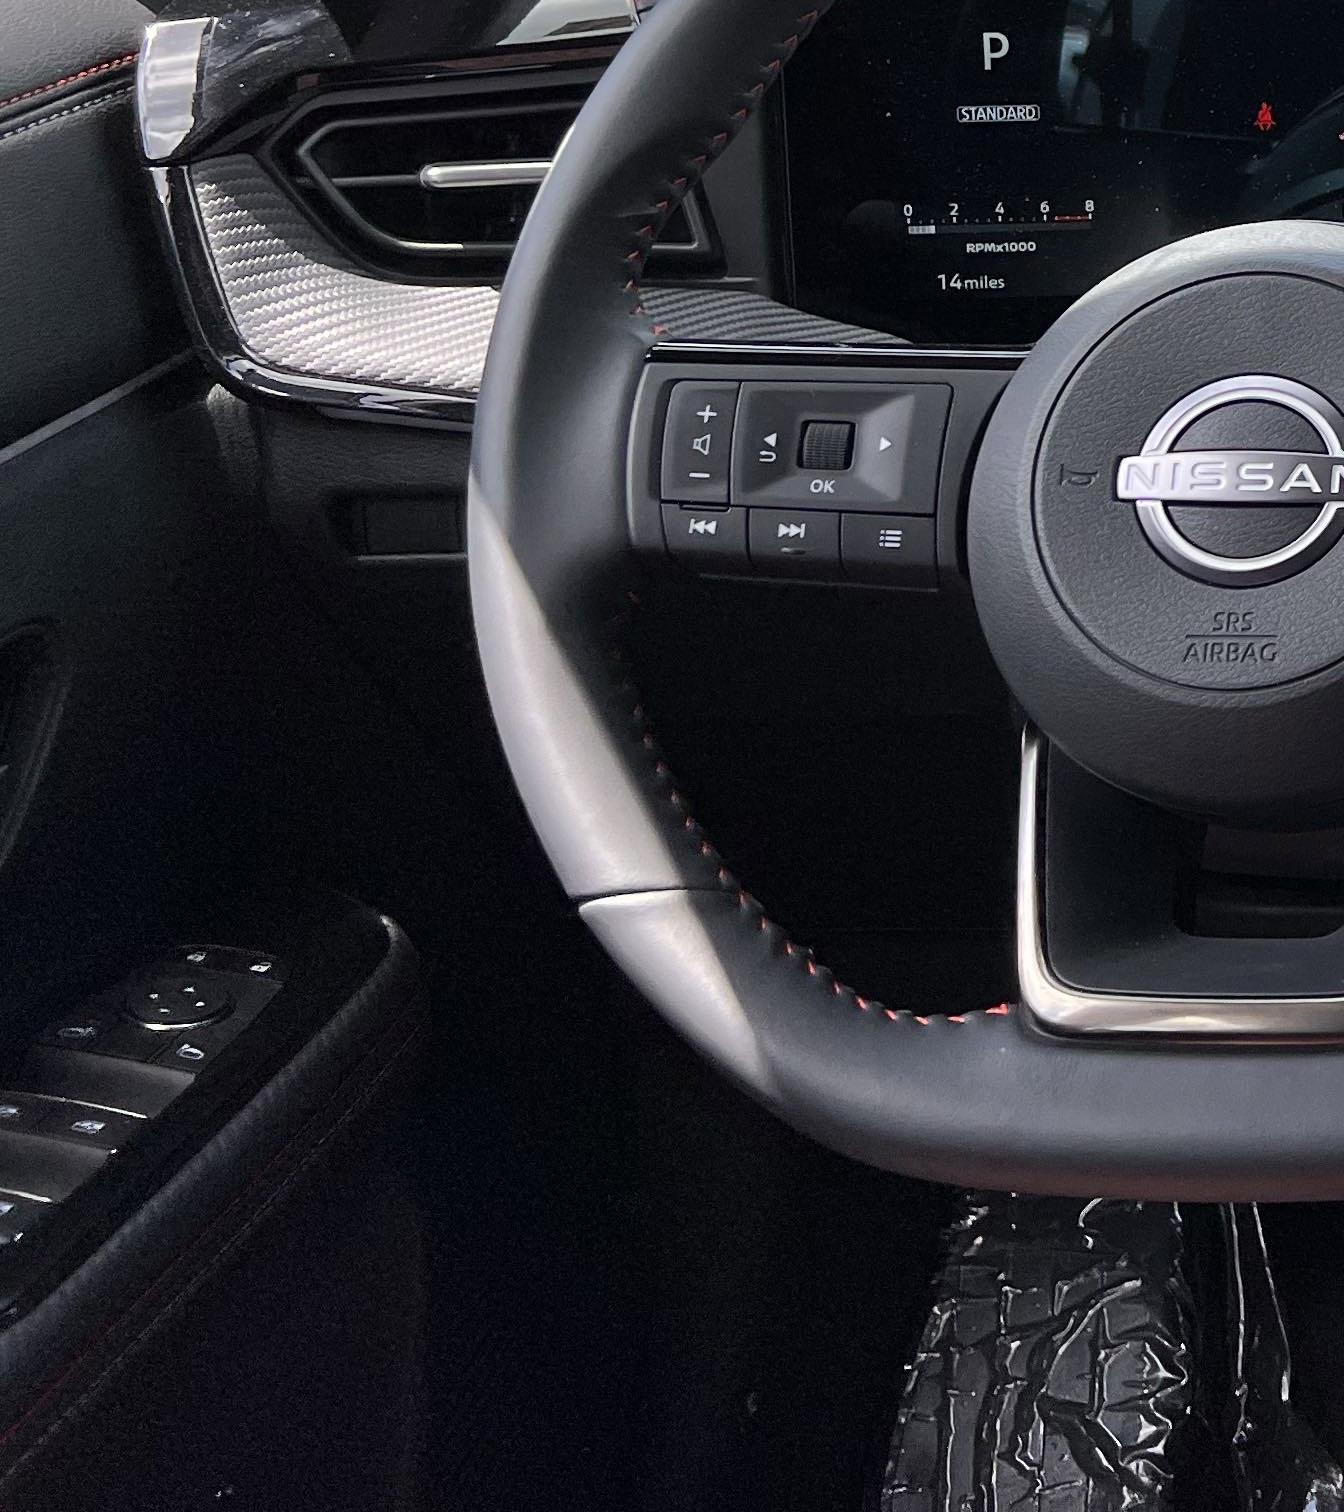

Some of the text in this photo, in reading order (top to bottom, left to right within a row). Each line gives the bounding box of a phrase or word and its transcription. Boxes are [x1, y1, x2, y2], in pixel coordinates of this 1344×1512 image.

[982, 31, 1010, 71] P
[960, 106, 1036, 121] STANDARD
[904, 200, 1095, 217] 0 2 4 6 8
[966, 240, 1036, 253] RPMx1000
[810, 480, 836, 494] OK
[1212, 611, 1254, 633] SRS
[1182, 641, 1278, 663] AIRBAG
